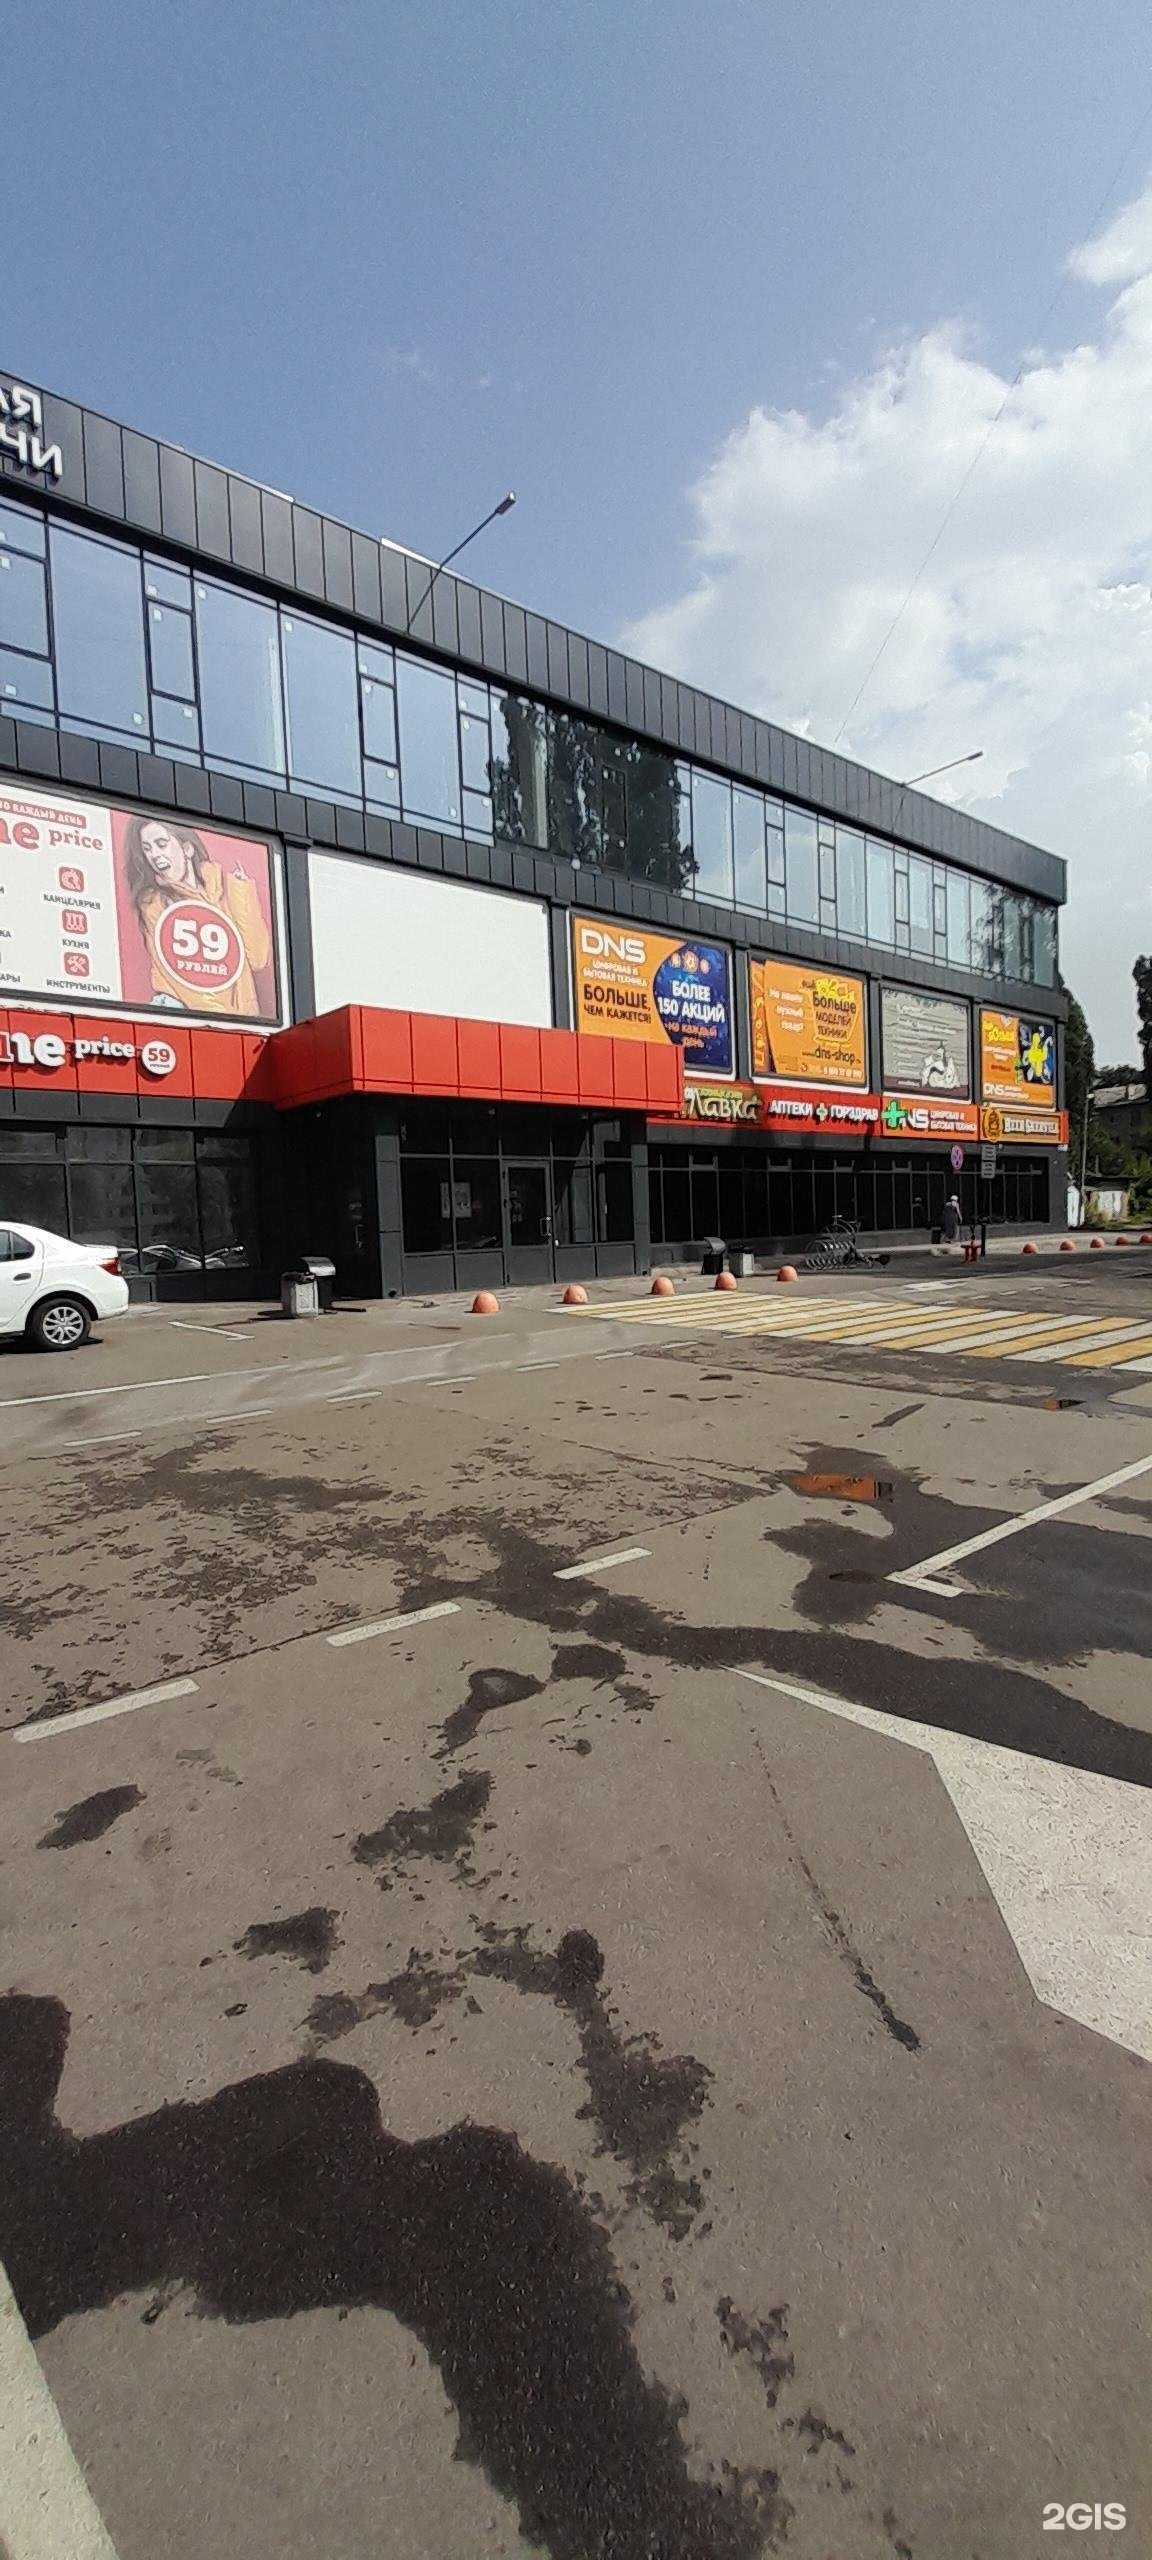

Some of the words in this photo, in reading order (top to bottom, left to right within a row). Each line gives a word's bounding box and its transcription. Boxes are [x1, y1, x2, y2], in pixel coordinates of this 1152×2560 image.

[48, 828, 104, 851] price
[172, 919, 229, 961] 59
[581, 928, 646, 964] DNS
[584, 983, 651, 1011] БОЛЬШЕ,
[672, 980, 711, 1002] БОЛЕЕ
[681, 1001, 725, 1023] АКЦИЙ
[74, 1036, 136, 1059] price
[148, 1047, 171, 1063] 59
[769, 1100, 813, 1116] АПТЕКИ
[899, 1108, 929, 1131] NS
